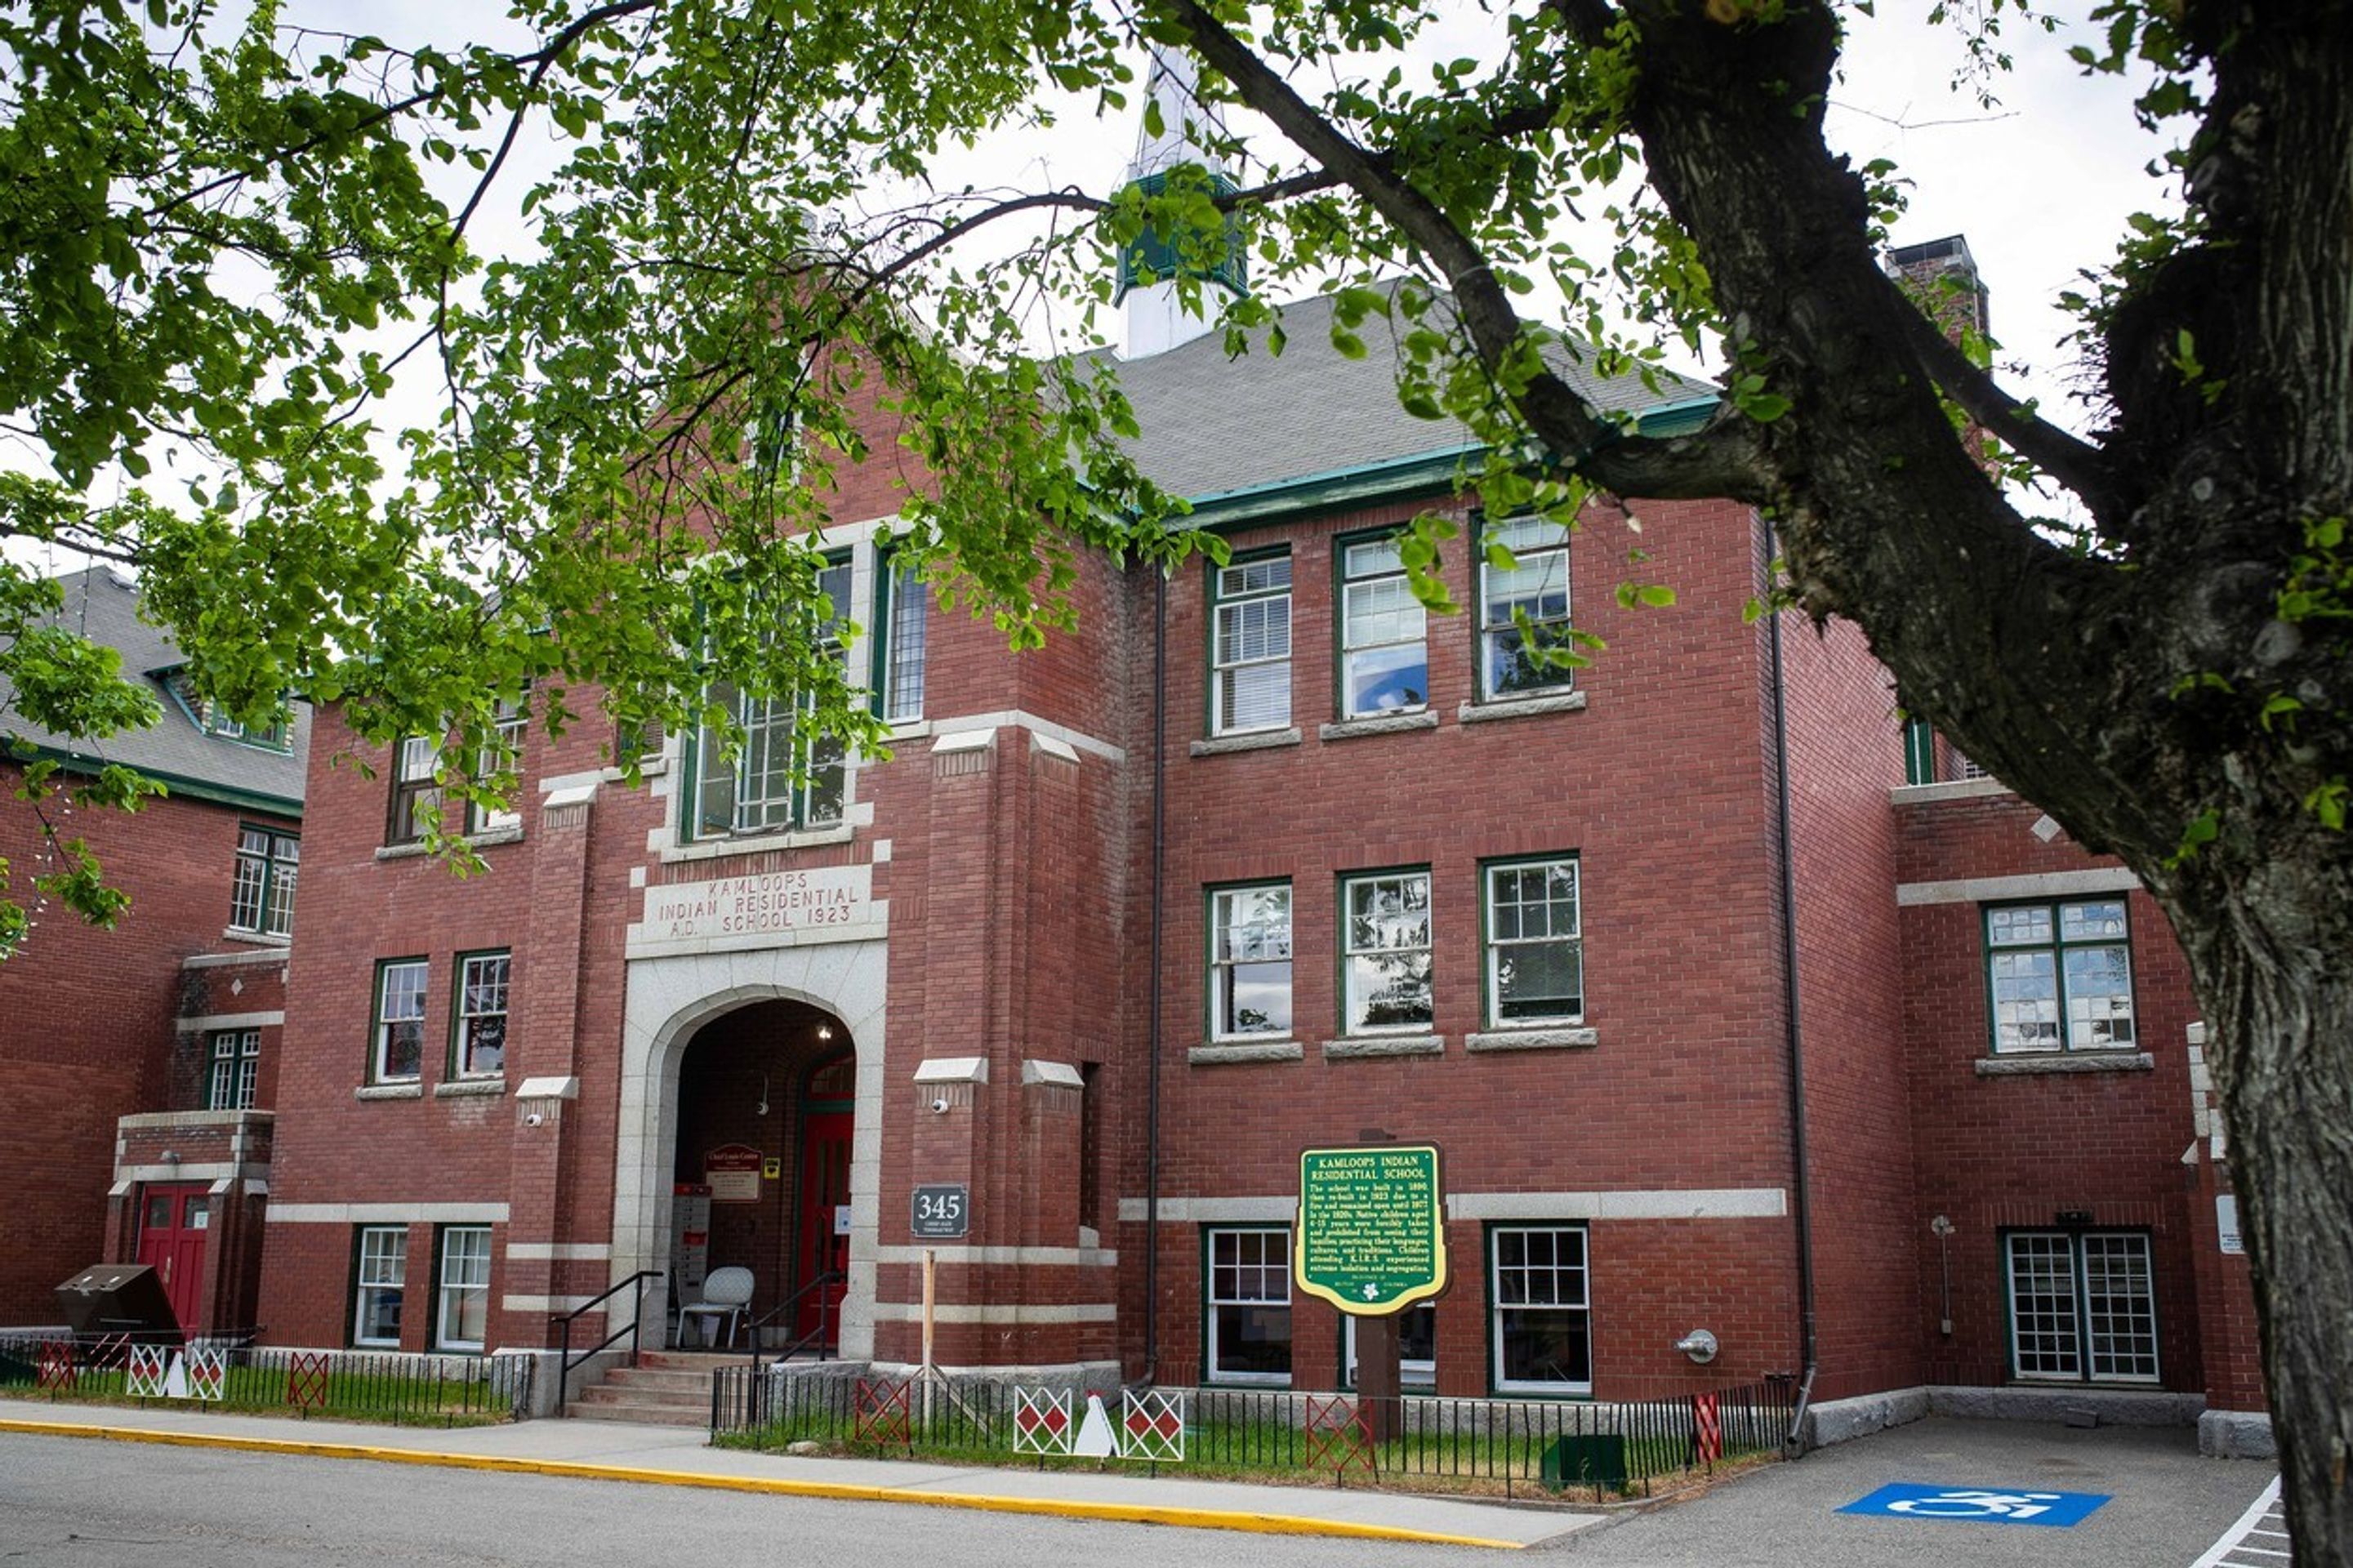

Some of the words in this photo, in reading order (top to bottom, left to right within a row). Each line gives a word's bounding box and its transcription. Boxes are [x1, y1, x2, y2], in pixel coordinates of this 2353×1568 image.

[708, 873, 808, 897] KAMLOOPS
[659, 900, 718, 920] INDIAN
[735, 886, 858, 914] RESIDENTIAL
[670, 921, 698, 936] A.D.
[723, 912, 792, 932] SCHOOL
[807, 906, 851, 924] 1923
[1319, 1157, 1375, 1168] KAMLOOPS
[1381, 1156, 1418, 1166] INDIAN
[1311, 1170, 1378, 1181] RESIDENTIAL
[1384, 1169, 1426, 1179] SCHOOL
[918, 1195, 960, 1219] 345
[1412, 1211, 1429, 1219] aged
